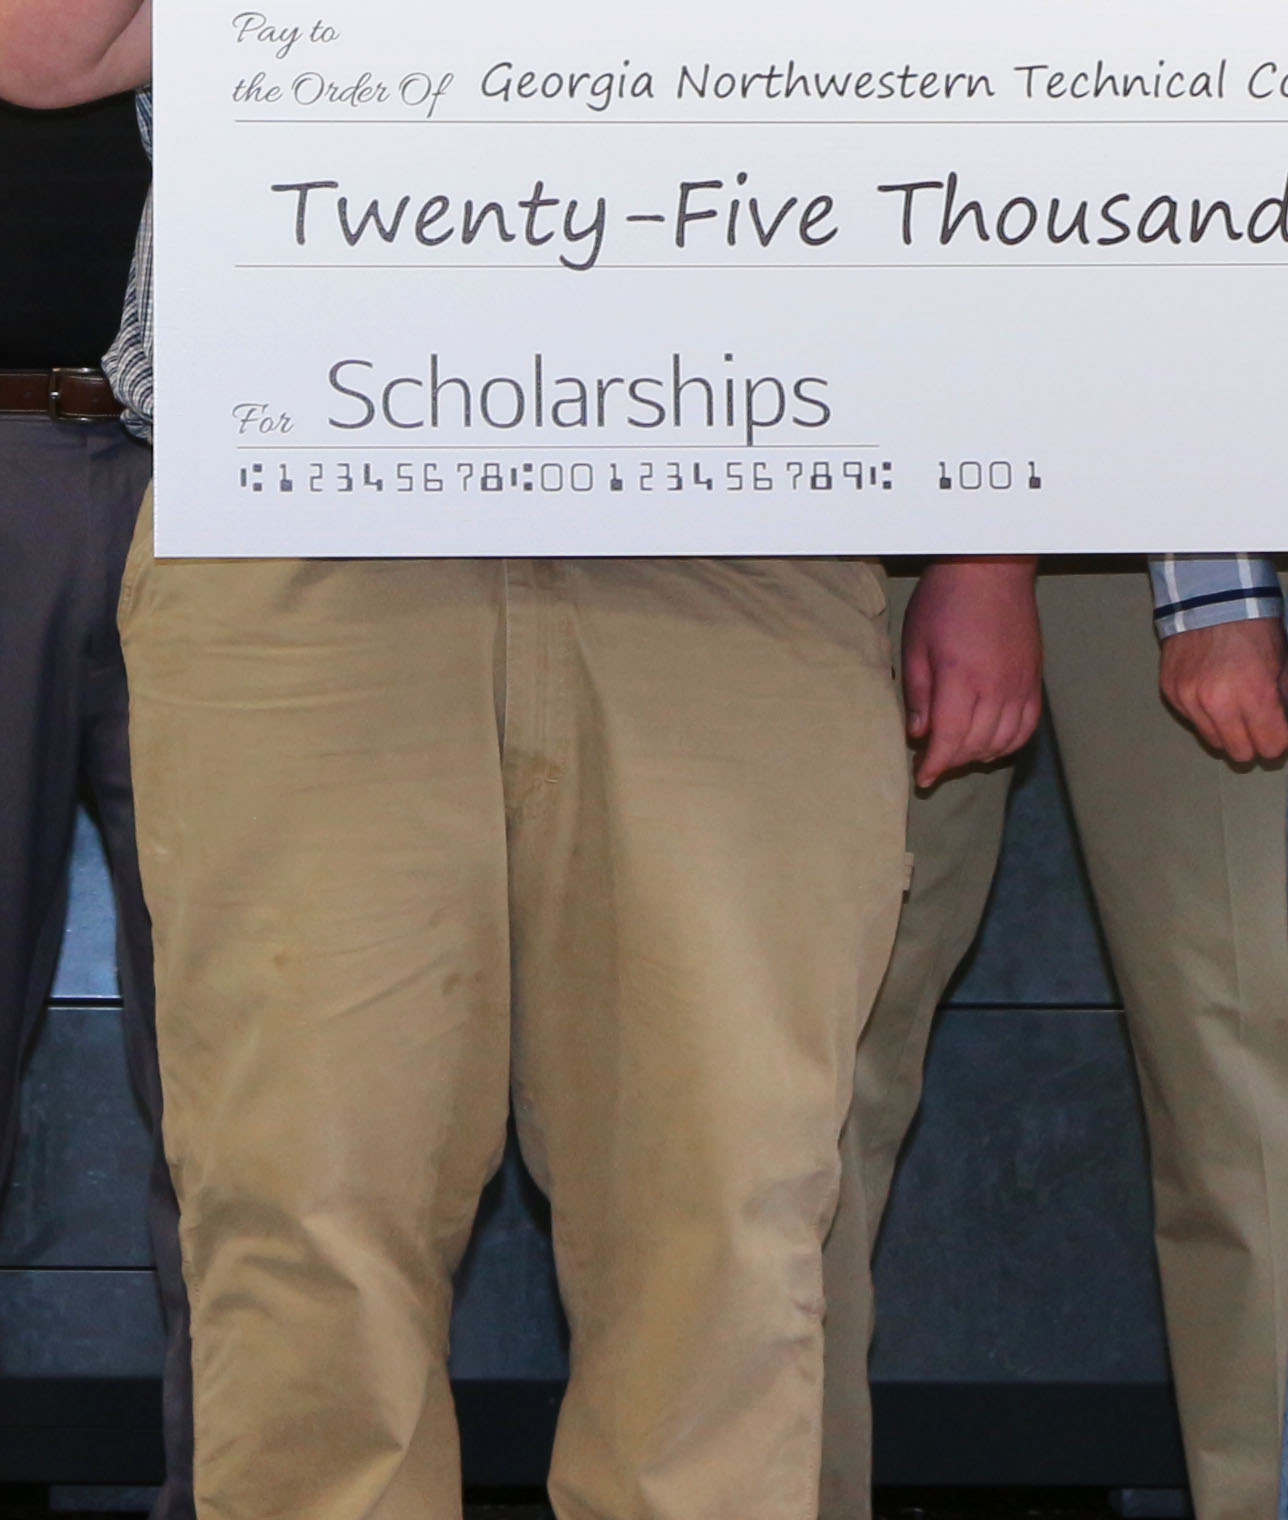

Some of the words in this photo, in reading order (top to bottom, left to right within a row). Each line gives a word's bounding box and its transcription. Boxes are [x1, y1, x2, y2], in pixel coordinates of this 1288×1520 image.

[231, 11, 303, 60] Pay
[309, 19, 341, 44] to
[231, 71, 283, 104] the
[290, 72, 389, 107] Order
[398, 72, 455, 118] Of
[480, 59, 655, 112] Georgia
[676, 59, 996, 100] Northwestern
[1012, 58, 1227, 100] Technical
[270, 171, 839, 270] Twenty-Five
[231, 402, 294, 435] For
[327, 353, 832, 446] Scholarships
[938, 460, 1042, 491] 1001
